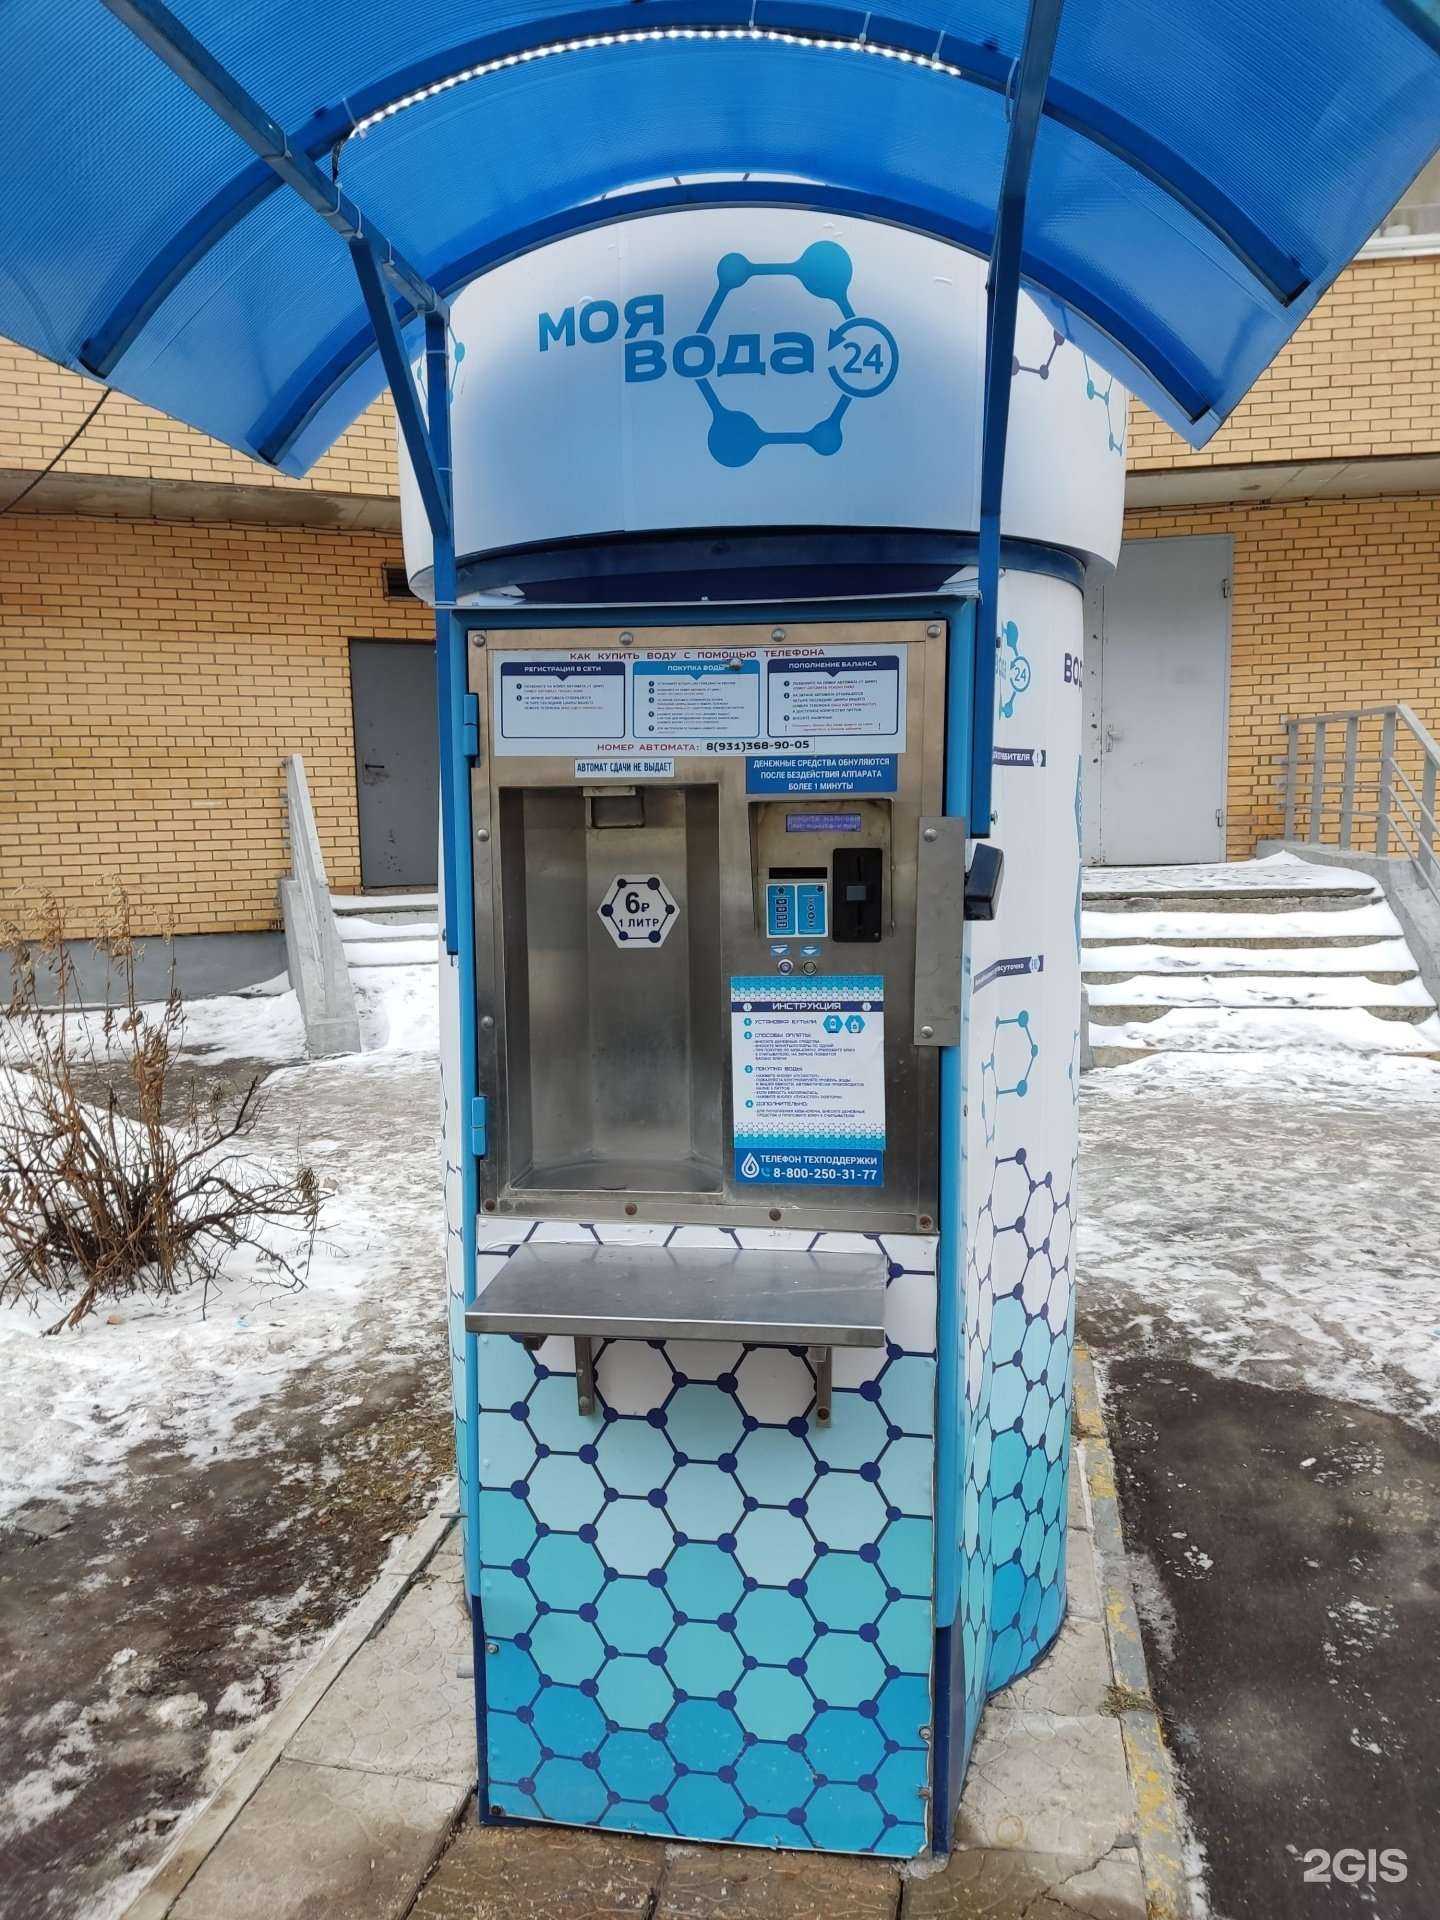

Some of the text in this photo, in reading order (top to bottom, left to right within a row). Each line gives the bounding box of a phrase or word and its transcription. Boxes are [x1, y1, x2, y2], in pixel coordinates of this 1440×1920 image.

[843, 342, 885, 384] 24
[598, 652, 640, 660] КУПИТЬ
[647, 651, 676, 661] ВОДУ
[684, 651, 692, 659] С
[698, 650, 757, 660] ПОМОЩЬЮ
[765, 649, 824, 657] ТЕЛЕФОНА
[1013, 664, 1026, 683] 24
[597, 740, 810, 752] НОМЕР АВТОМАТА: 8(931)368-90-05
[577, 761, 671, 773] АВТОМАТ СДАЧИ НЕ ВЫДАЕТ
[753, 757, 889, 768] ДЕНЕЖНЫЕ СРЕДСТВА ОБНУЛЯЮТСЯ
[760, 769, 882, 779] ПОСЛЕ БЕЗДЕЙСТВИЯ АППАРАТА
[788, 782, 854, 790] БОЛЕЕ 1 МИНУТЫ
[619, 918, 660, 928] 1 ЛИТР
[772, 1002, 842, 1010] ИНСТРУКЦИЯ
[760, 1155, 877, 1166] ТЕЛЕФОН ТЕХПОДДЕРЖКИ
[773, 1167, 877, 1180] 8-800-250-31-77
